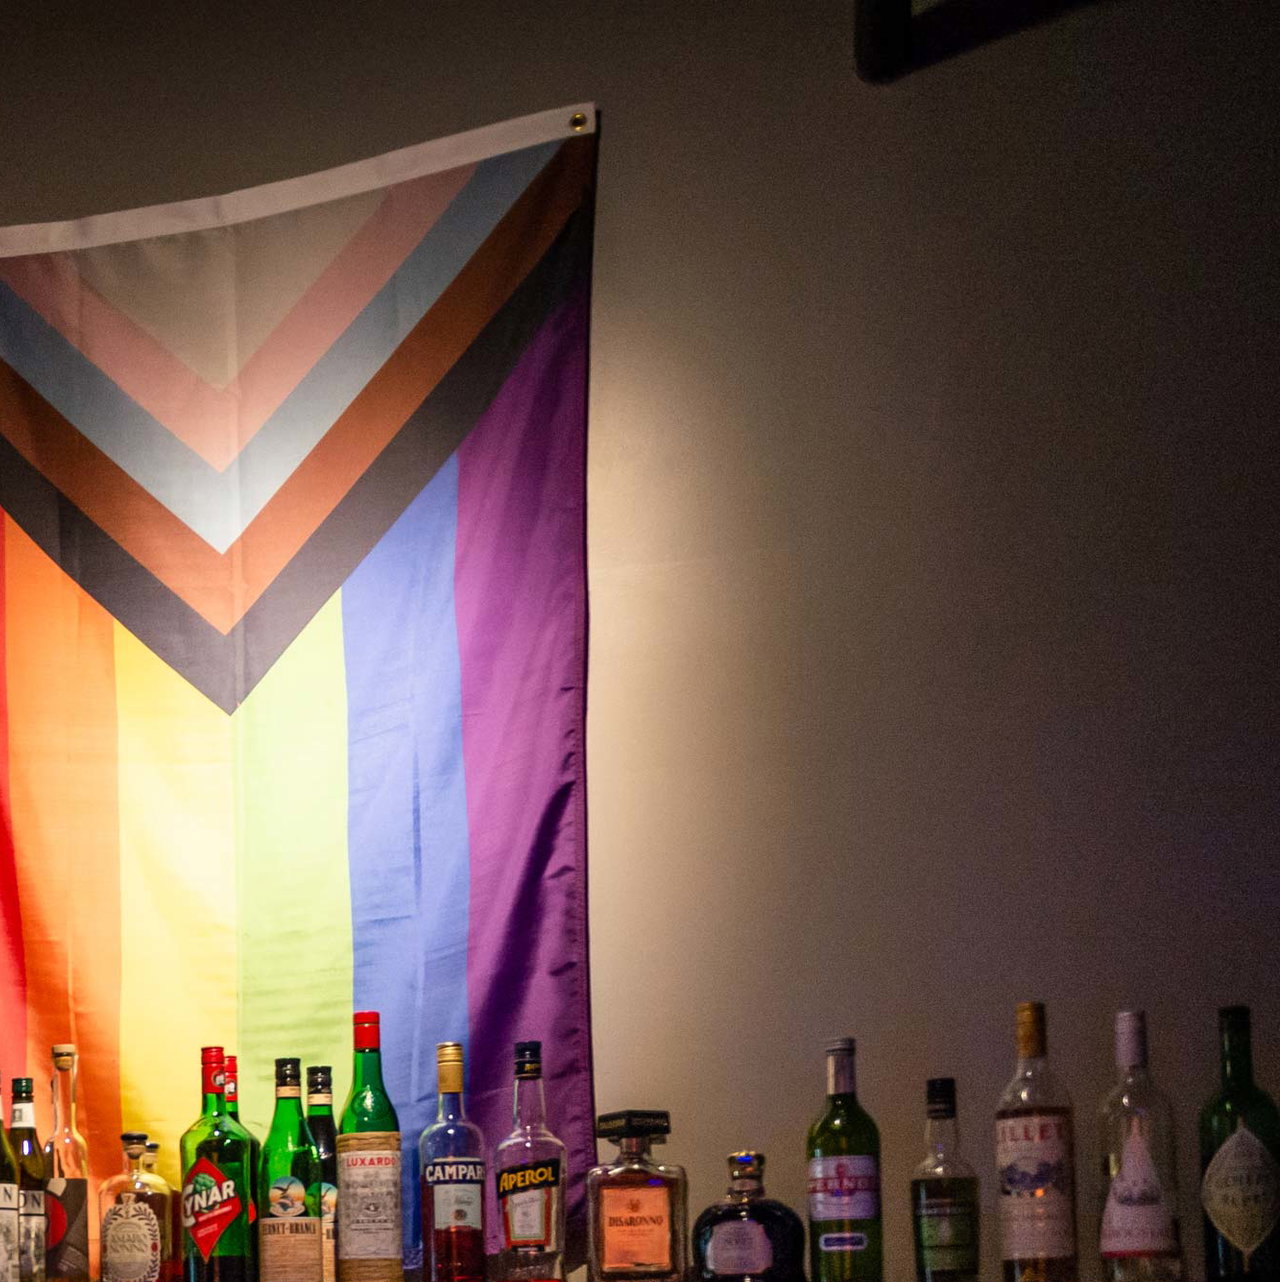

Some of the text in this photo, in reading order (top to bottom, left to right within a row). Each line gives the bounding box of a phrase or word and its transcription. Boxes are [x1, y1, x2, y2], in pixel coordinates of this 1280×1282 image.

[346, 1156, 397, 1168] LUXARDO
[499, 1166, 555, 1193] APEROL
[182, 1179, 236, 1228] CYNAR
